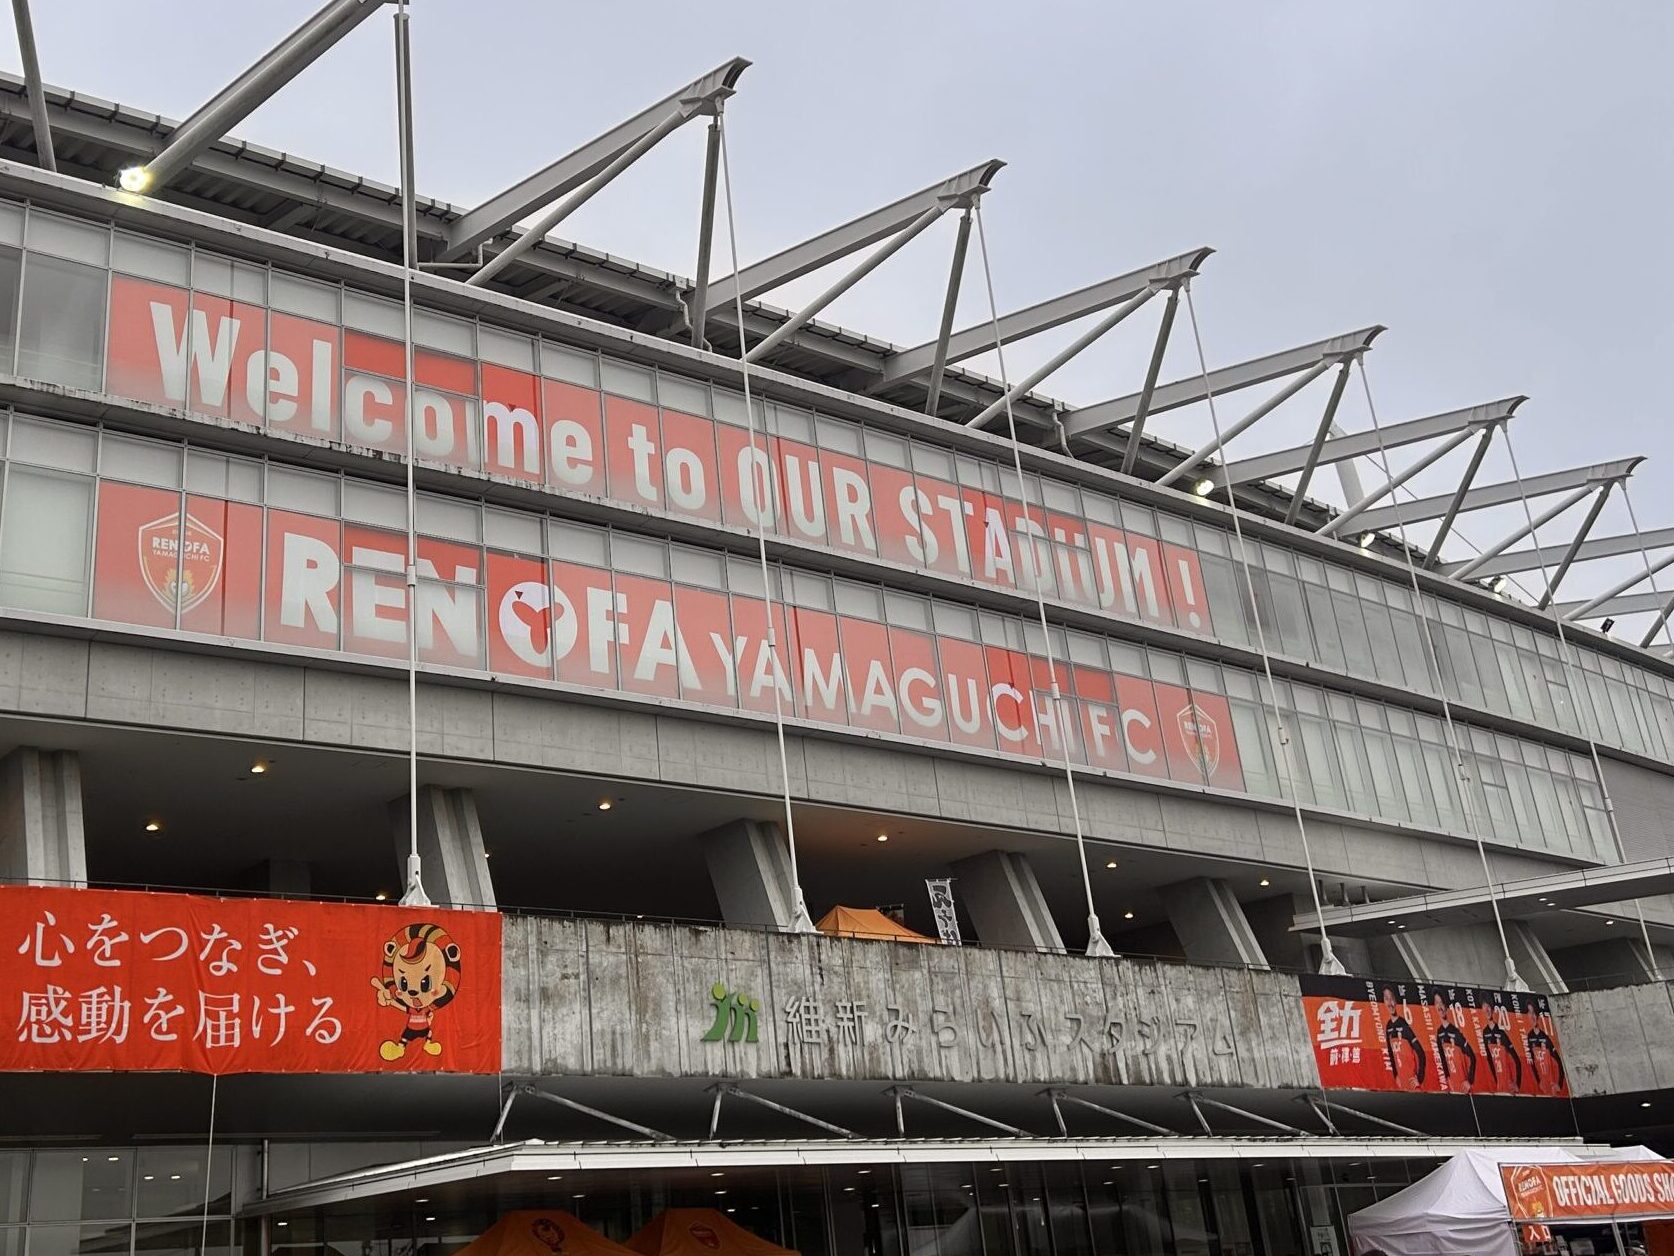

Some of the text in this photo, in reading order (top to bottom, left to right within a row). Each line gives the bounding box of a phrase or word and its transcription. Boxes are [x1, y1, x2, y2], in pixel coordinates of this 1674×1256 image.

[150, 301, 593, 485] Welcome
[628, 423, 706, 509] to
[738, 446, 877, 551] OUR
[899, 485, 1160, 618] STADIUM
[152, 537, 210, 554] RENOFA
[280, 531, 1158, 765] RENOFA YAMAGUCHI FC
[18, 910, 317, 977] 心をつなぎ、
[16, 983, 343, 1049] 感動を届ける
[785, 995, 1234, 1056] 維新みらいふスタジアム
[1449, 1002, 1465, 1029] 18
[1494, 1005, 1511, 1031] 20
[1553, 1174, 1615, 1207] OFFICIAL
[1610, 1173, 1655, 1204] GOODS
